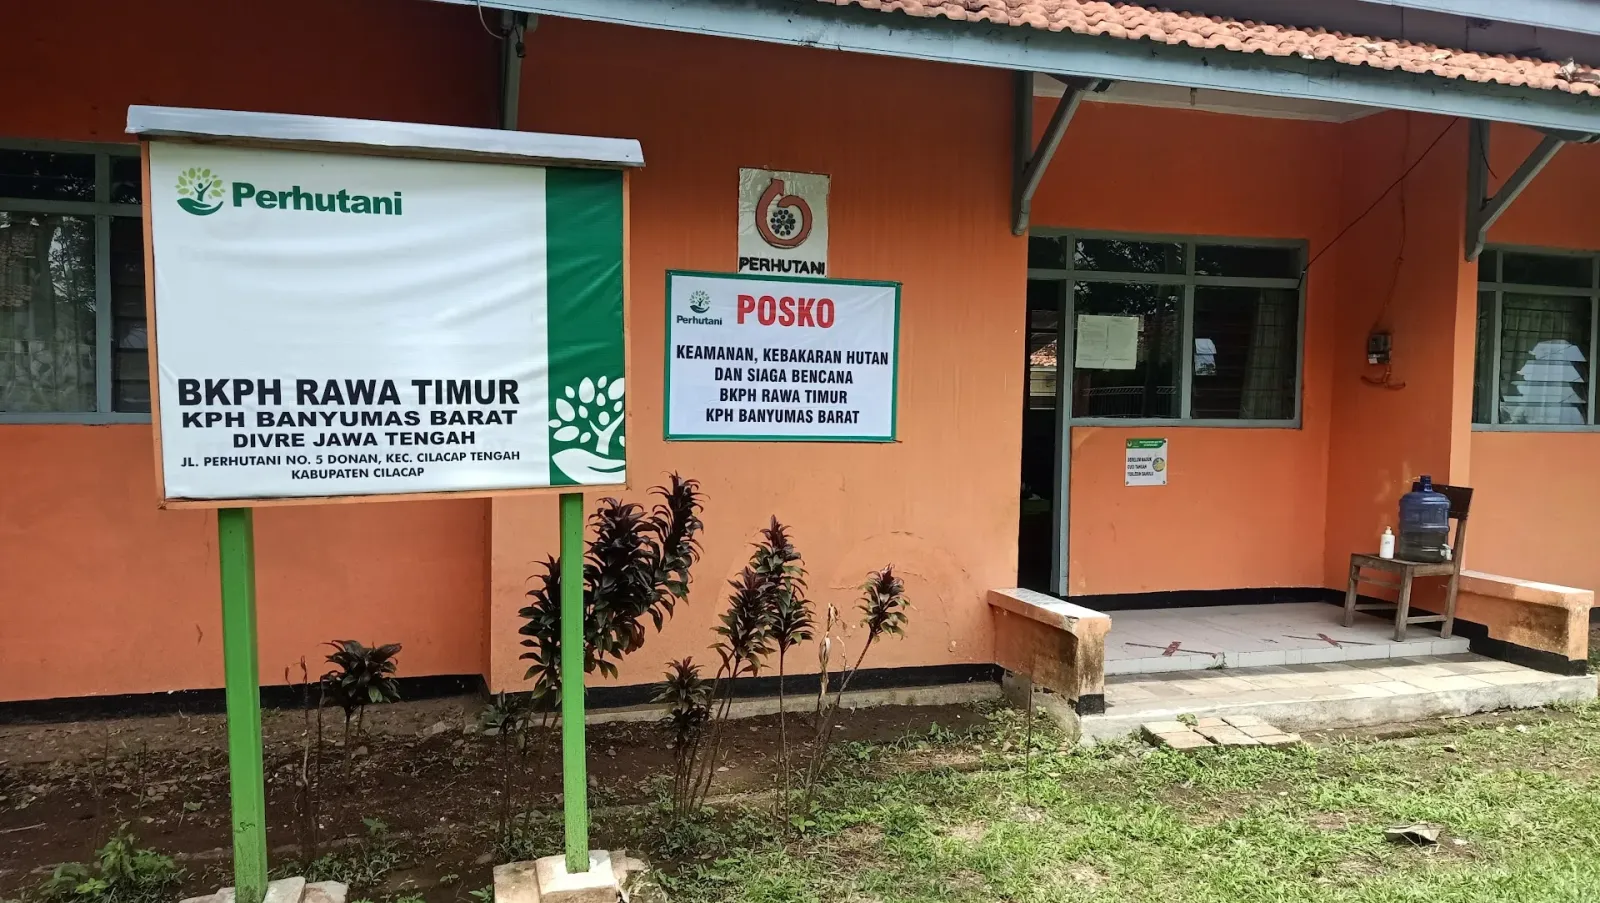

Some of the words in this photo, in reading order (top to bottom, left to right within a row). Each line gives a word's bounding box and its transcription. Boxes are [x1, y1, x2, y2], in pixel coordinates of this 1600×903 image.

[232, 182, 402, 215] Perhutani
[739, 257, 825, 275] PERHUTANI
[677, 315, 722, 325] Perhutani
[738, 295, 834, 328] POSKO
[677, 345, 757, 363] KEAMANAN,
[764, 348, 841, 363] KEBAKARAN
[847, 351, 888, 365] HUTAN
[715, 367, 742, 381] DAN
[748, 368, 786, 382] SIAGA
[792, 370, 853, 384] BENCANA
[178, 379, 281, 405] BKPH
[297, 379, 401, 405] RAWA
[412, 380, 519, 405] TIMUR
[720, 388, 756, 401] BKPH
[762, 389, 800, 402] RAWA
[805, 390, 847, 403] TIMUR
[183, 412, 244, 428] KPH
[257, 411, 420, 427] BANYUMAS
[431, 410, 517, 425] BARAT
[707, 408, 733, 422] KPH
[739, 409, 813, 423] BANYUMAS
[818, 410, 859, 423] BARAT
[234, 433, 304, 448] DIVRE
[313, 433, 378, 446] JAWA
[385, 431, 474, 445] TENGAH
[181, 458, 198, 467] JL.
[204, 456, 280, 466] PERHUTANI
[286, 455, 310, 464] NO.
[316, 455, 323, 464] 5
[328, 454, 381, 464] DONAN,
[386, 454, 412, 462] KEC.
[417, 452, 466, 462] CILACAP
[470, 451, 519, 460] TENGAH
[292, 469, 368, 479] KABUPATEN
[374, 468, 424, 477] CILACAP
